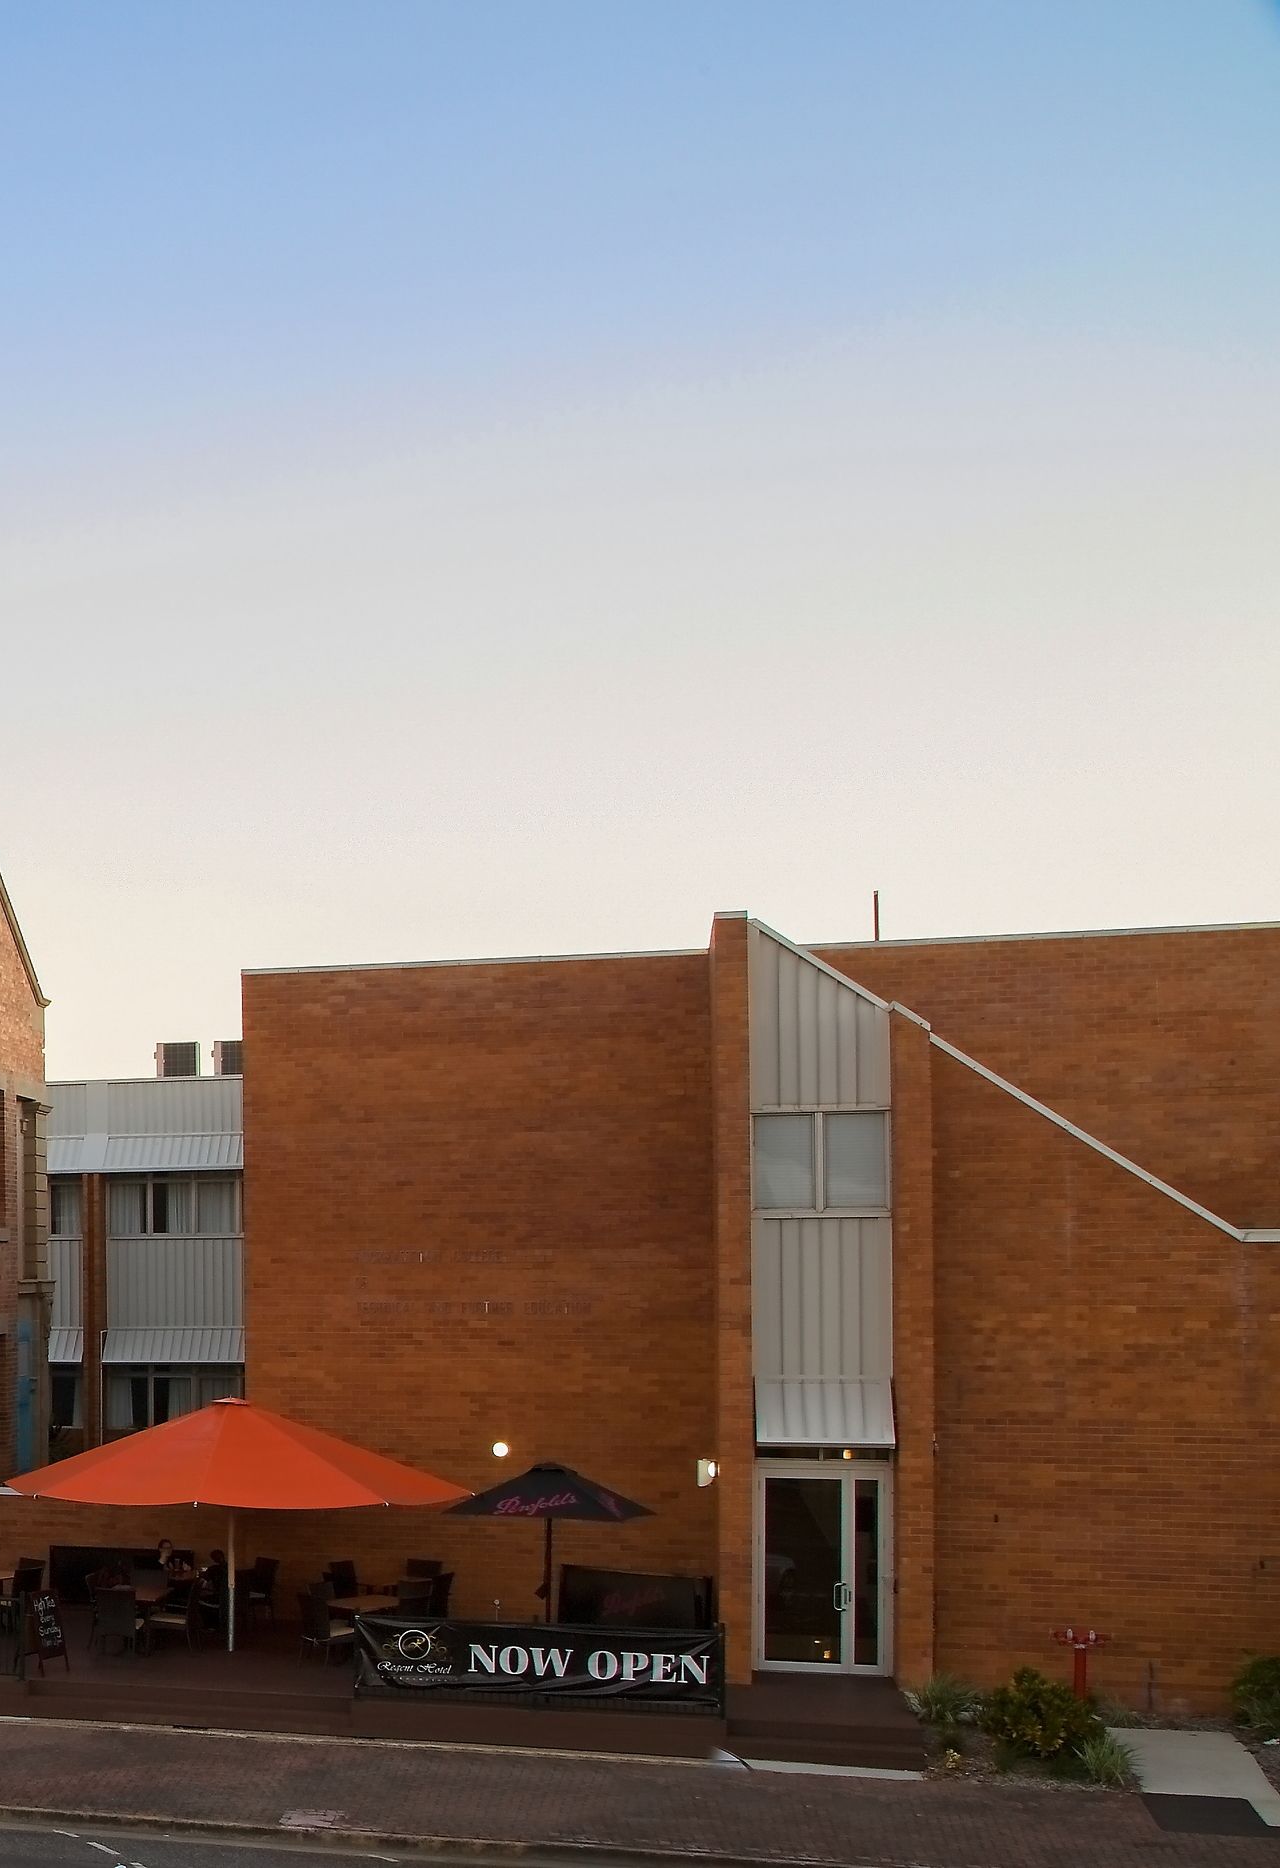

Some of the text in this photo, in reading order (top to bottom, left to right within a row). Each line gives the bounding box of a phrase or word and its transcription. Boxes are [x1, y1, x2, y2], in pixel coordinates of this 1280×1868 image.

[493, 1492, 577, 1517] Penfolds
[38, 1625, 62, 1639] Sunday
[376, 1660, 453, 1674] Regent Hotel
[468, 1643, 711, 1685] NOW OPEN
